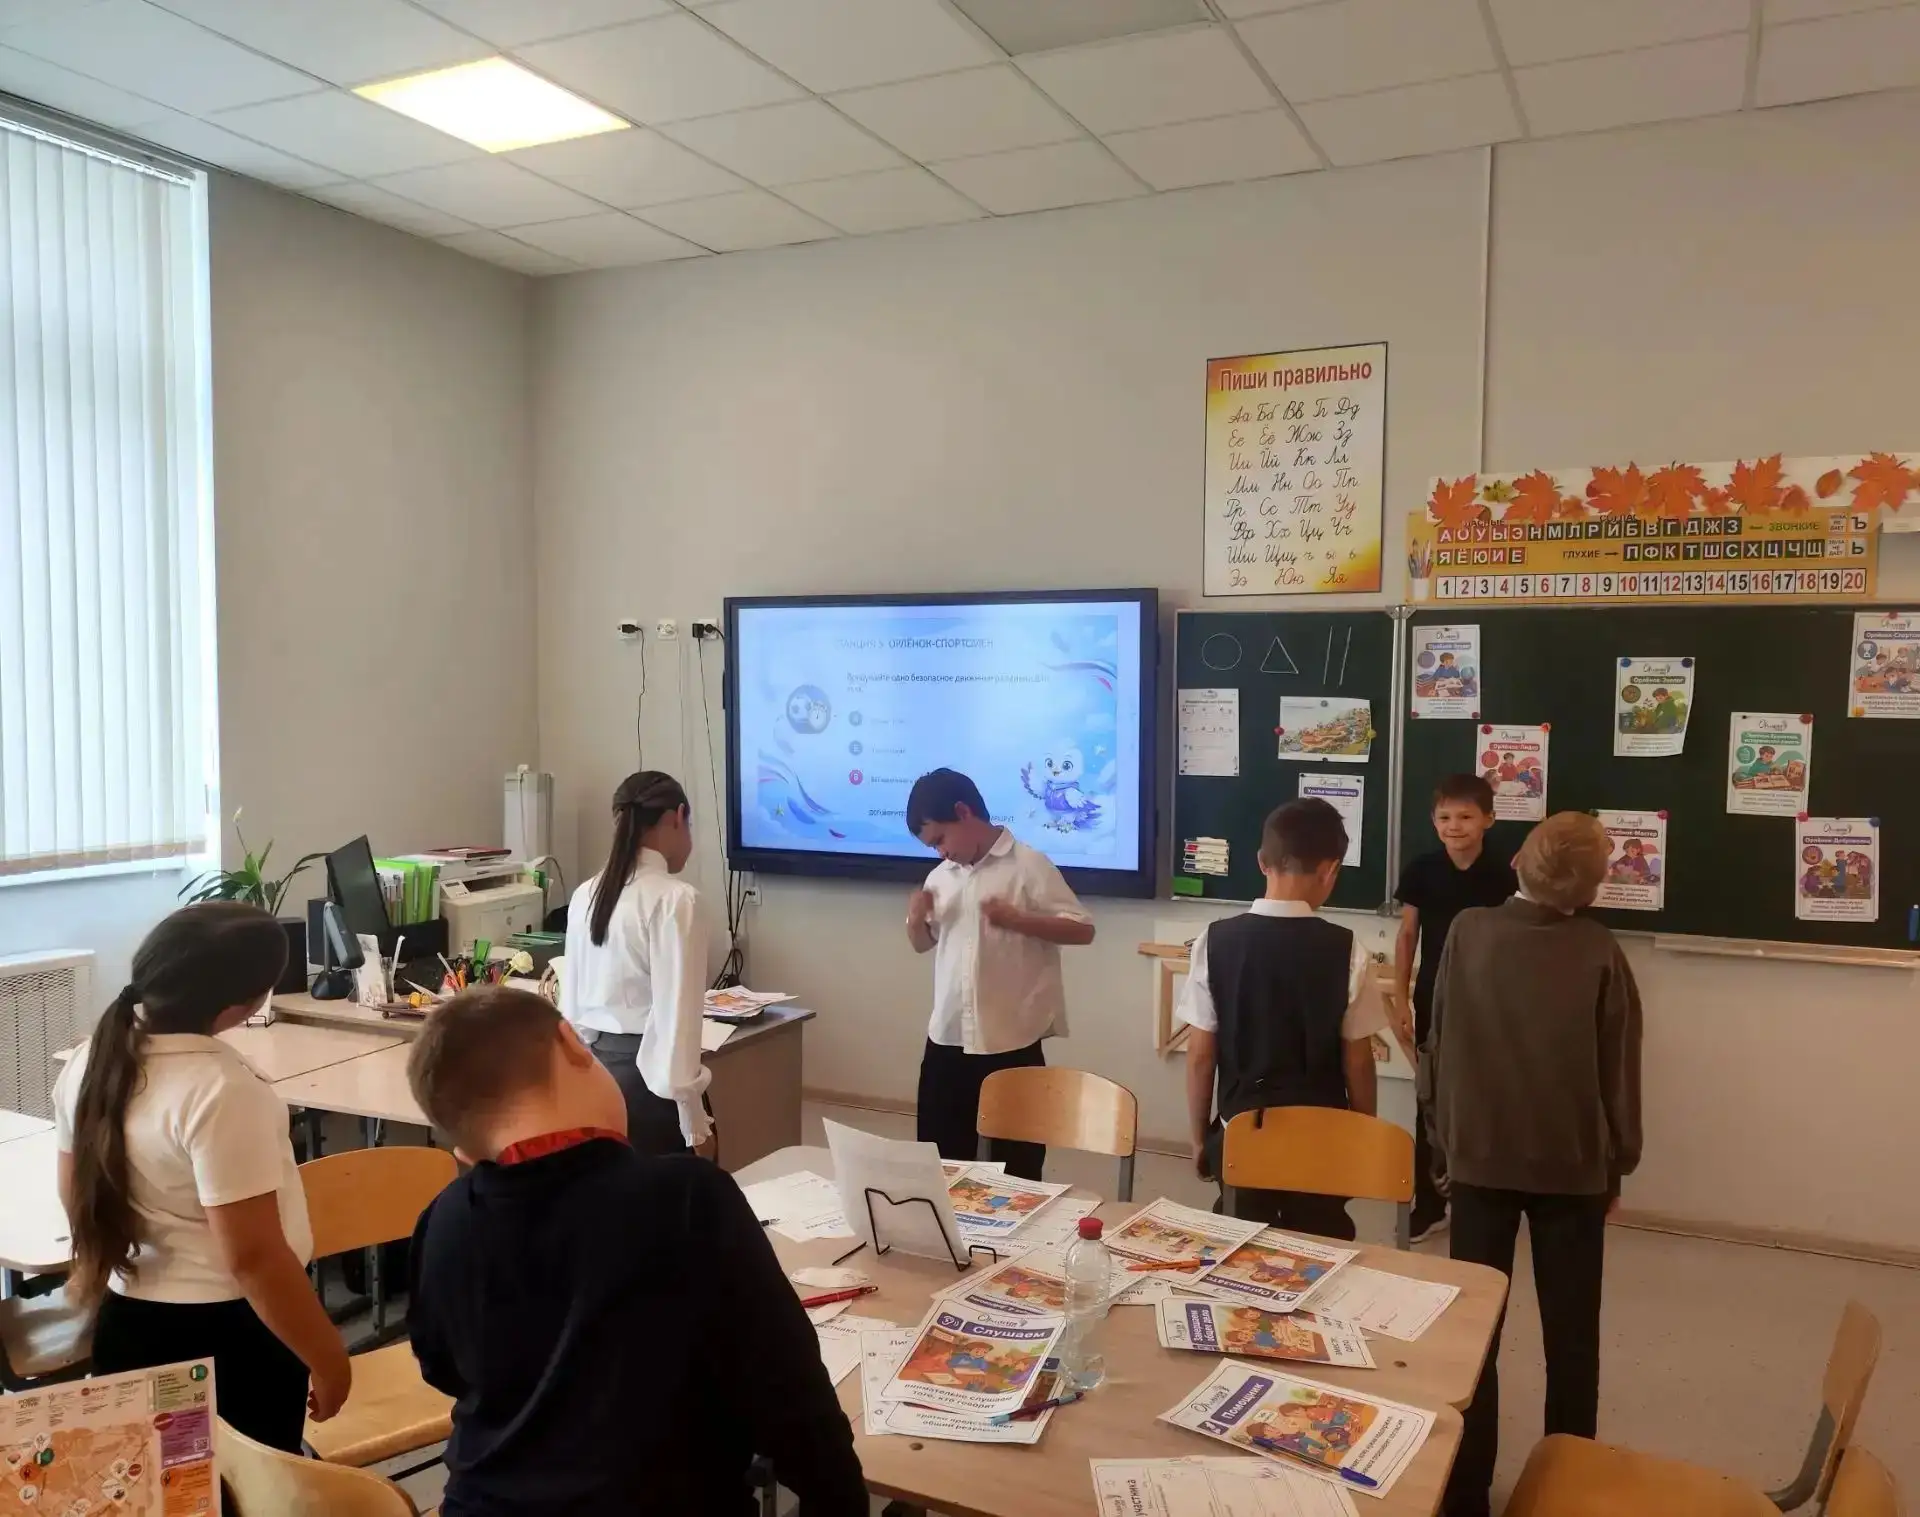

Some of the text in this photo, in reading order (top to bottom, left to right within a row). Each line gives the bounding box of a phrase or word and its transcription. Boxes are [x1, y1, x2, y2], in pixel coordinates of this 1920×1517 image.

[1220, 361, 1373, 392] Пиши правильно
[1769, 522, 1821, 532] ЗВОНКИЕ
[1563, 550, 1600, 559] ГЛУХИЕ
[1443, 572, 1863, 595] 1 2 3 4 5 6 7 8 9 10 11 12 13 14 15 16 17 18 19 20
[910, 672, 953, 682] безопасное
[972, 1325, 1046, 1338] Слушаем
[1221, 1380, 1266, 1420] Помощник
